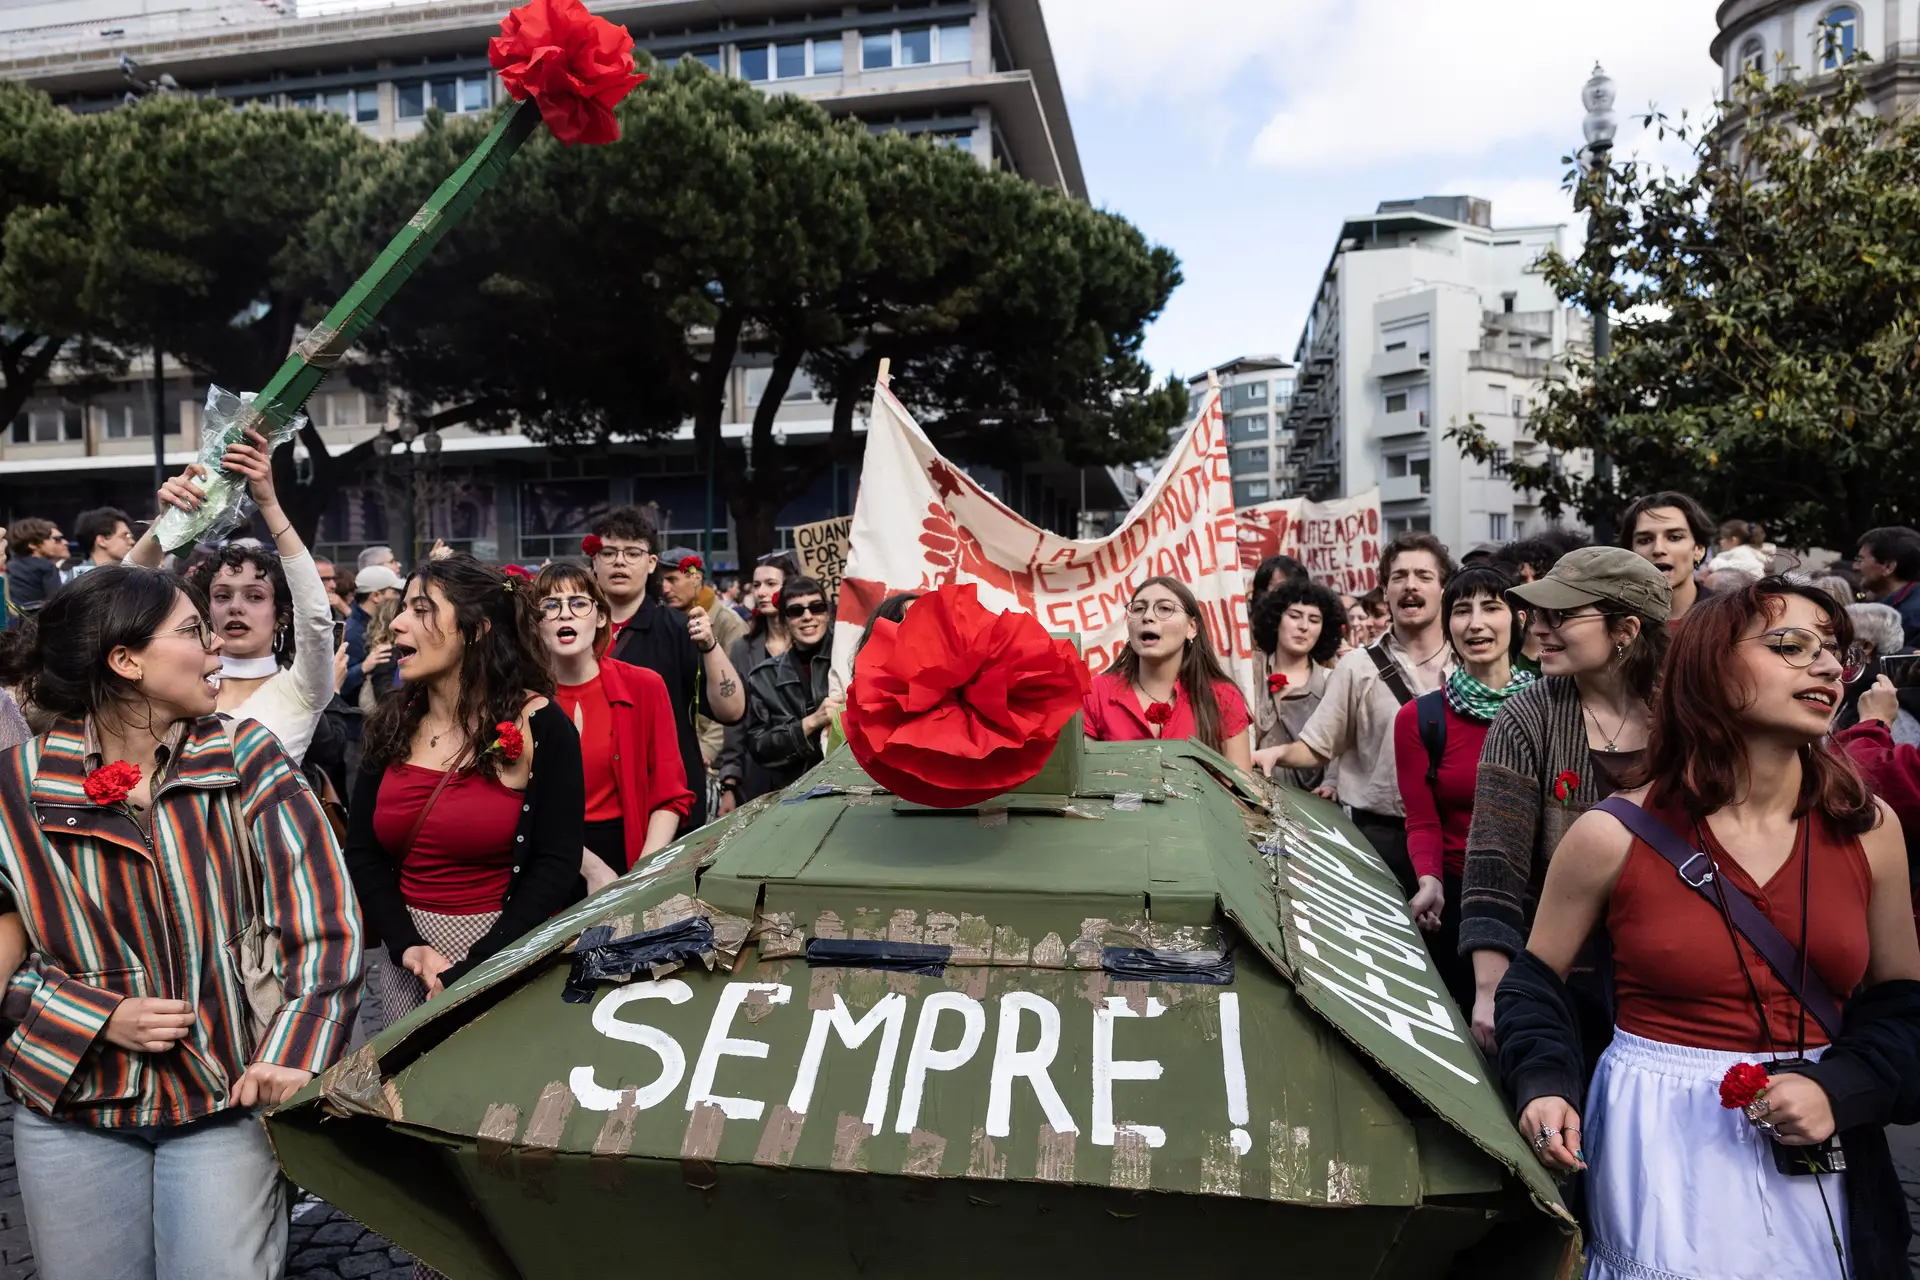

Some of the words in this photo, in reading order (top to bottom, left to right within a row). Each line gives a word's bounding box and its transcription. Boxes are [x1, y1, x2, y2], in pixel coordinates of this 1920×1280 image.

[803, 543, 841, 567] FOR
[1036, 453, 1235, 594] ESTUDANTES
[1307, 546, 1341, 572] ARTE
[1362, 540, 1381, 564] DA
[568, 979, 1252, 1156] SEMPRE!
